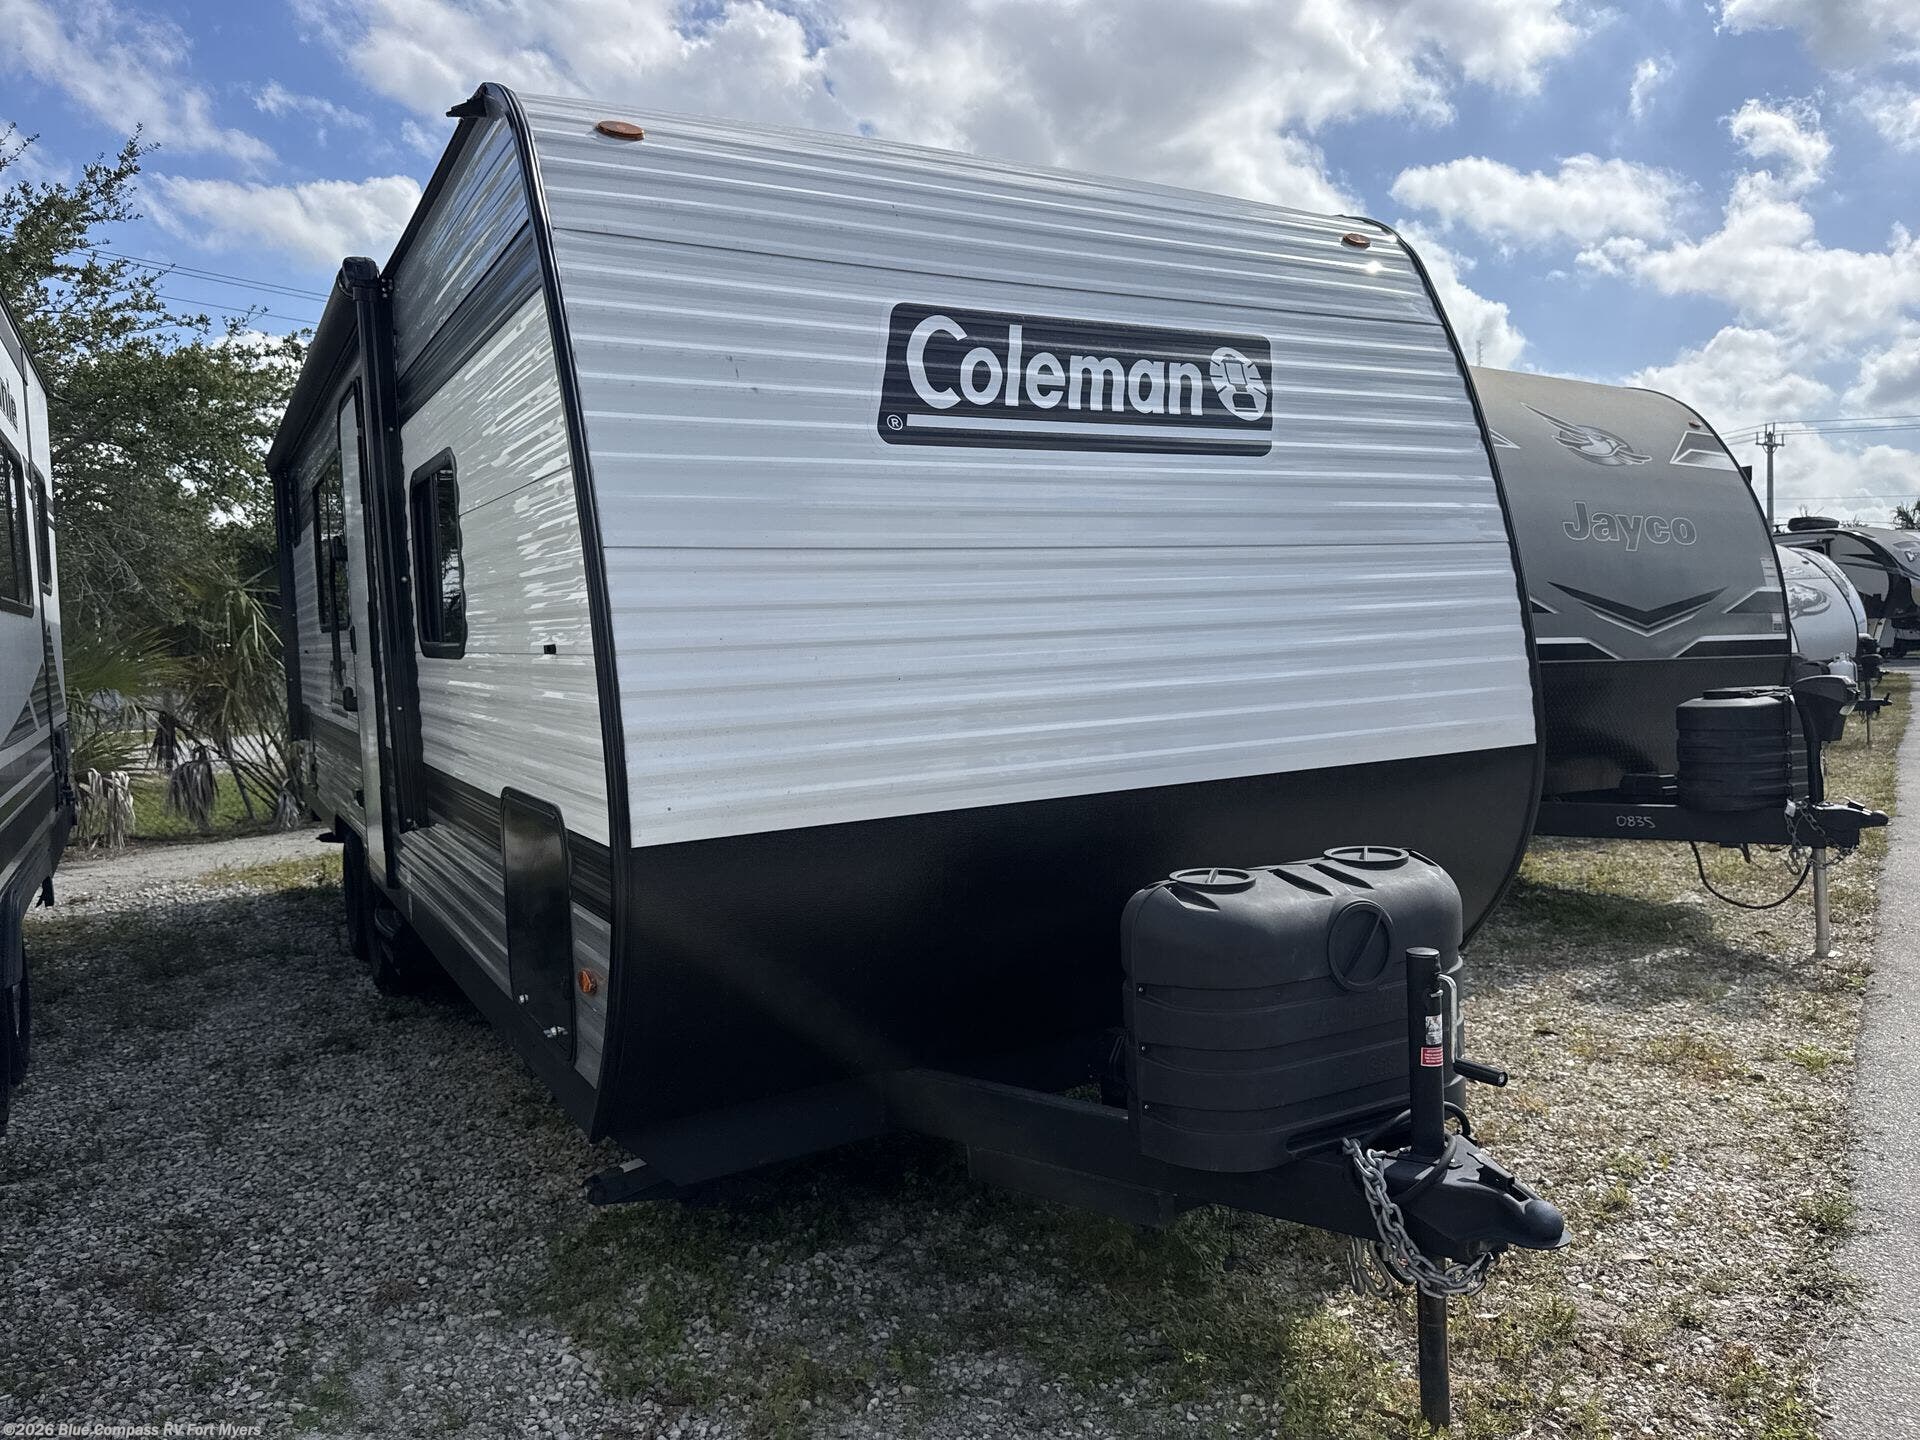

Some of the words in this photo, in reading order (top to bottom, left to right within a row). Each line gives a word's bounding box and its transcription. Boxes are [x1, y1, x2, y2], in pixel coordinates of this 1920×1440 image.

[906, 314, 1204, 416] Coleman
[0, 377, 18, 434] nie
[1562, 501, 1697, 552] Jayco
